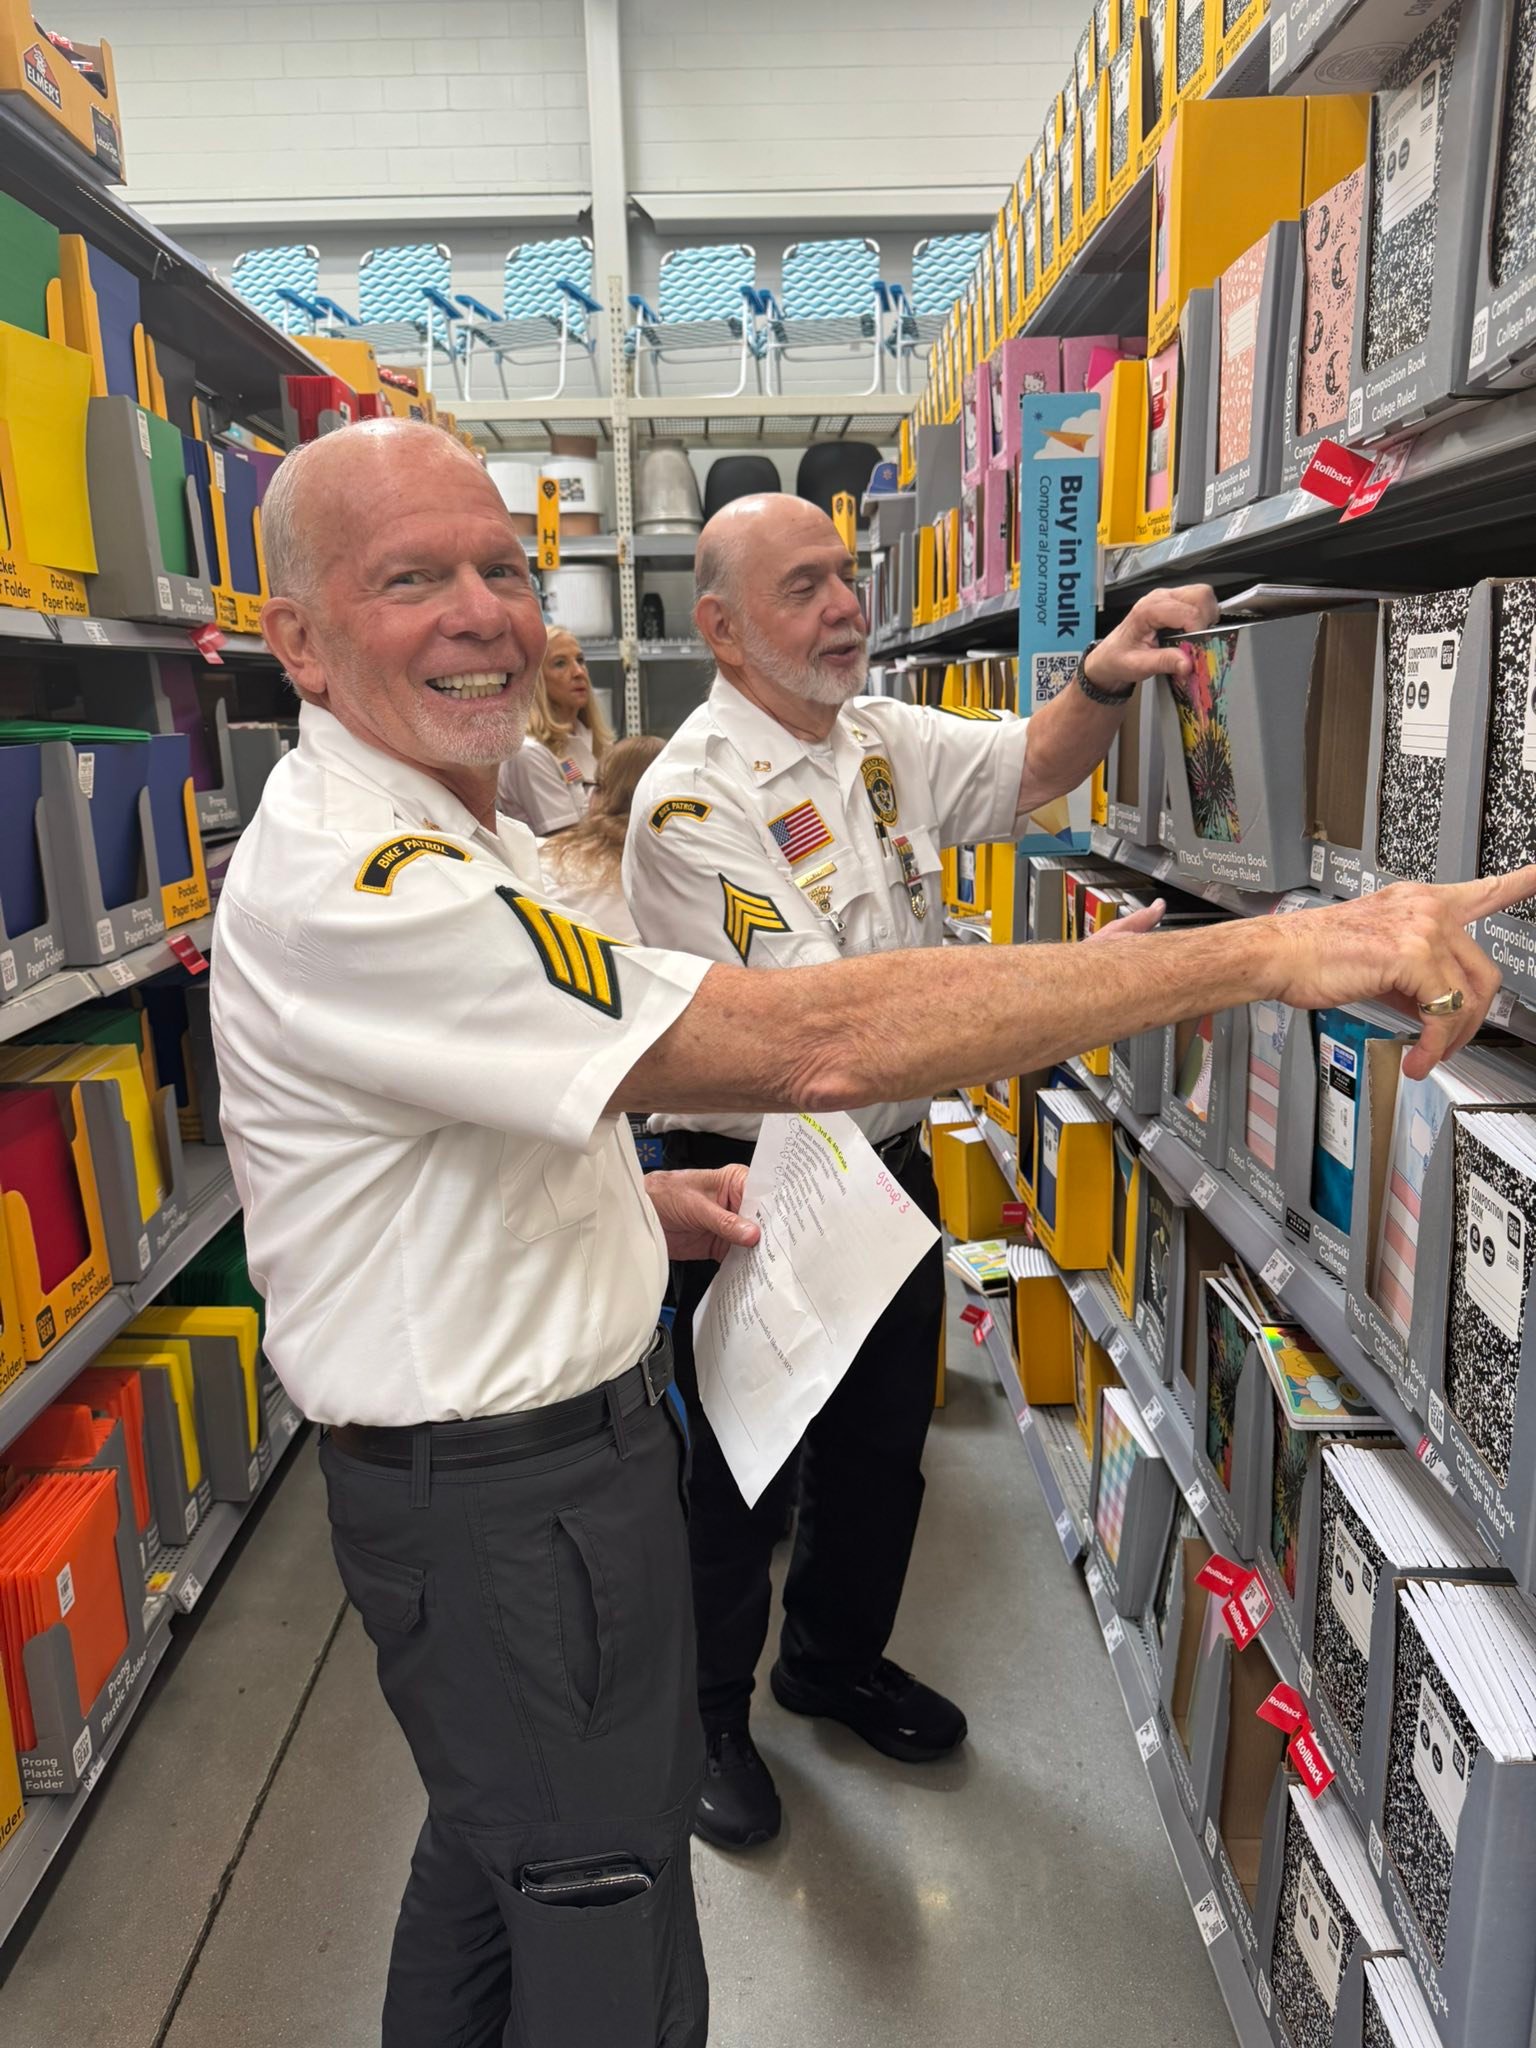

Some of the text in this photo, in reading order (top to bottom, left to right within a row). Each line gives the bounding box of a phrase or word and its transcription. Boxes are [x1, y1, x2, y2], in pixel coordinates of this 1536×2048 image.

[27, 64, 60, 104] ELMER'S
[1496, 317, 1524, 347] College
[1365, 352, 1427, 399] Composition Book
[1371, 384, 1417, 422] College Ruled
[1294, 432, 1337, 459] Compoion
[1214, 472, 1239, 494] Composition
[1312, 459, 1354, 488] Rollback
[543, 529, 556, 546] H
[1036, 475, 1052, 626] Comprar al por mayor
[0, 561, 17, 576] cket
[545, 551, 554, 567] 8
[1055, 475, 1083, 638] Buy in bulk
[5, 579, 31, 600] Folder
[50, 573, 75, 593] Pocket
[186, 583, 204, 601] Prong
[42, 592, 86, 613] Paper Folder
[180, 599, 197, 617] Paper
[197, 601, 215, 617] Folder
[1408, 646, 1438, 660] COMPOSITION
[1408, 661, 1420, 674] BOOK
[202, 808, 239, 825] Paper Folder
[209, 796, 227, 809] Prong
[672, 802, 696, 812] PATROL
[377, 839, 449, 870] BIKE PATROL
[1203, 847, 1247, 868] Composition
[1247, 853, 1268, 868] Book
[1330, 850, 1361, 872] Composit
[1212, 863, 1261, 882] College Ruled
[1335, 870, 1358, 892] College
[179, 883, 199, 899] Pocket
[131, 907, 153, 924] Prong
[172, 898, 208, 920] Paper Folder
[33, 934, 54, 954] Prong
[124, 920, 164, 946] Paper Folder
[26, 946, 65, 979] Paper Folder
[1492, 942, 1525, 975] College
[1168, 1101, 1195, 1130] Composition
[1194, 1121, 1207, 1140] Book
[1172, 1116, 1188, 1137] College
[838, 1151, 848, 1170] Grade
[1246, 1156, 1276, 1192] Composition
[876, 1171, 911, 1214] group 3
[1249, 1174, 1283, 1212] College Ruled
[1471, 1186, 1504, 1222] COMPOSITION
[1471, 1199, 1484, 1221] BOOK
[1313, 1224, 1350, 1261] Compositi
[1319, 1245, 1348, 1275] College
[70, 1266, 96, 1298] Pocket
[63, 1272, 111, 1325] Plastic Folder
[1368, 1312, 1408, 1368] Composition
[1410, 1358, 1427, 1391] Book
[1374, 1337, 1398, 1375] College
[1449, 1424, 1516, 1533] Composition Book
[1456, 1454, 1505, 1539] College Ruled
[1204, 1565, 1235, 1587] Rollback
[1227, 1599, 1249, 1640] Rollback
[100, 1650, 149, 1734] Plastic Folder
[107, 1659, 131, 1699] Prong
[1267, 1695, 1303, 1721] Rollback
[1315, 1688, 1366, 1797] Composition Book
[1319, 1713, 1359, 1797] College Ruled
[21, 1757, 58, 1768] Prong
[23, 1766, 64, 1779] Plastic
[1295, 1736, 1324, 1786] Rollback
[25, 1779, 65, 1790] Folder
[0, 1803, 22, 1841] lder
[1219, 1849, 1259, 1953] Composition Book
[1387, 1869, 1450, 2020] Composition Book
[1393, 1899, 1439, 2017] College Ruled
